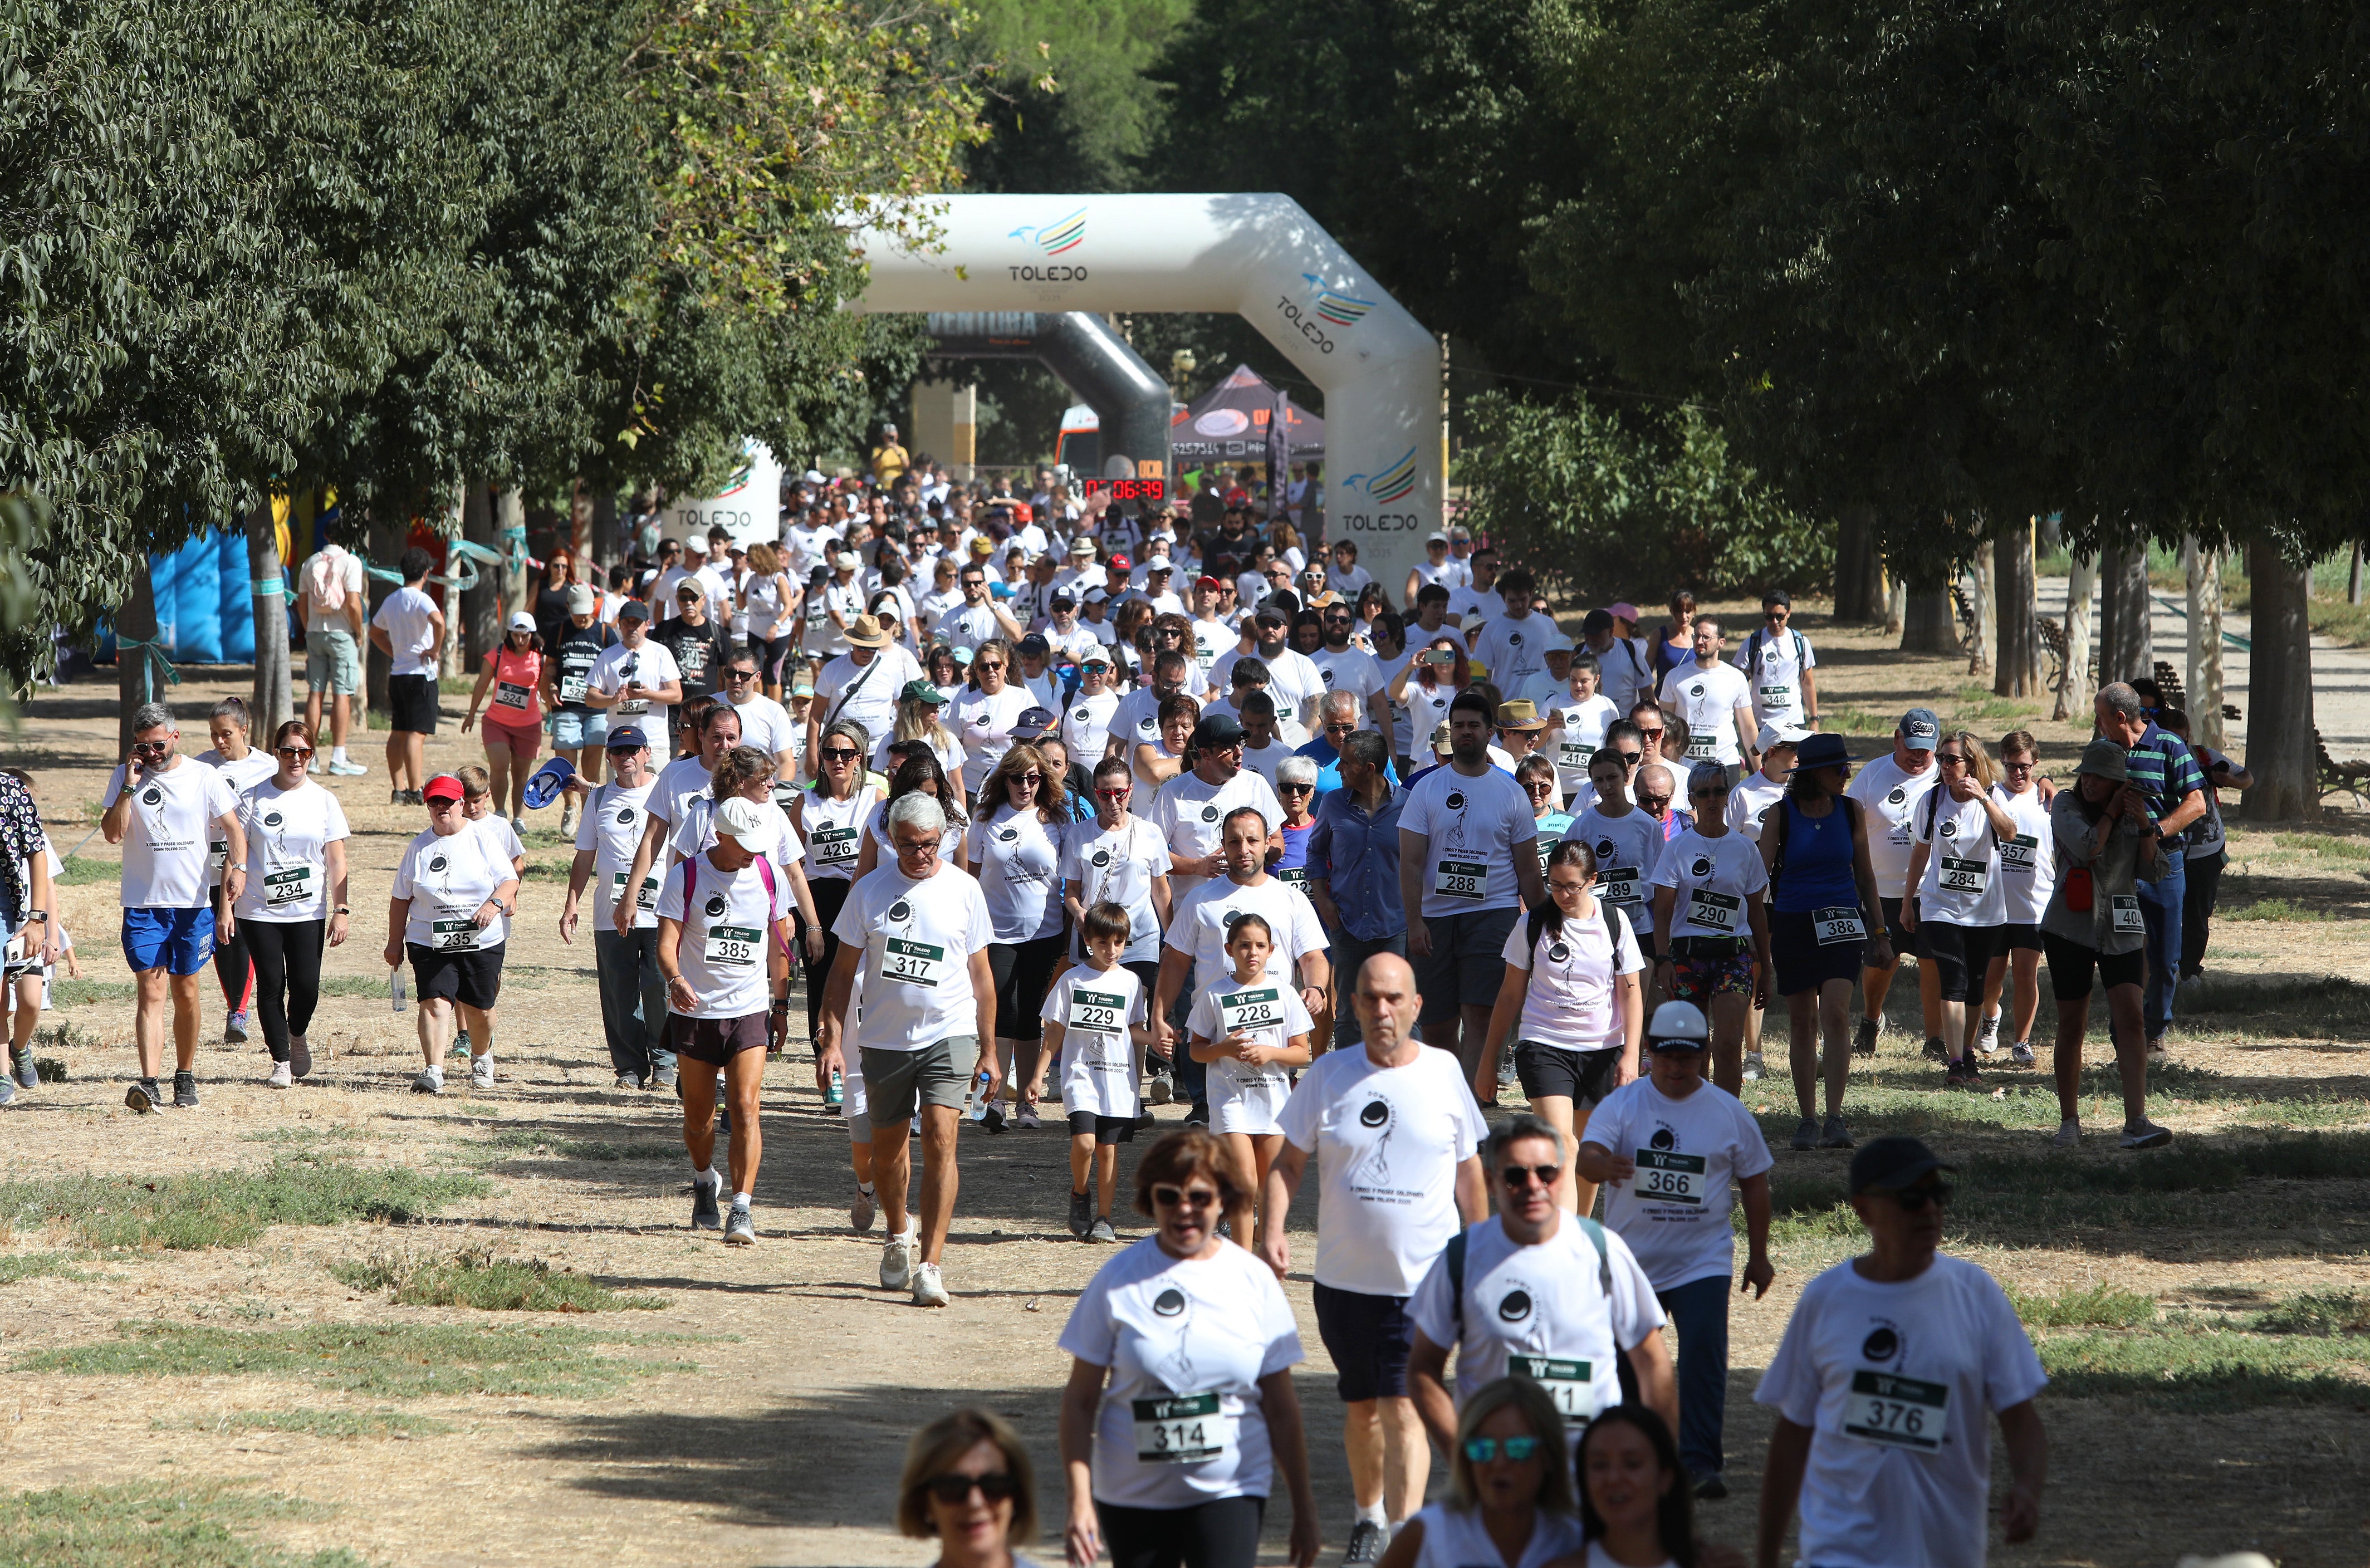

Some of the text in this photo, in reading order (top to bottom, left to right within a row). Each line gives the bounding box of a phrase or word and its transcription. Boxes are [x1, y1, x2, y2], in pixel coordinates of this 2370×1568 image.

[1008, 266, 1088, 281] TOLEDO
[1277, 295, 1334, 354] TOLEDO
[677, 509, 751, 526] TOLEDO
[1343, 514, 1418, 530] TOLEDO
[503, 692, 521, 704] 524
[569, 688, 588, 698] 525
[1767, 695, 1785, 704] 348
[622, 701, 640, 711] 387
[1689, 746, 1710, 756] 414
[1566, 753, 1587, 765] 415
[823, 841, 851, 857] 426
[2001, 845, 2028, 860] 357
[1446, 876, 1476, 891] 288
[1948, 871, 1976, 886] 284
[275, 881, 303, 899] 234
[709, 890, 725, 899] DOWN
[894, 895, 911, 903] DOWN
[1696, 905, 1727, 923] 290
[1827, 920, 1855, 935] 388
[443, 932, 471, 947] 235
[718, 941, 750, 958] 385
[895, 957, 931, 977] 317
[1081, 1007, 1114, 1025] 229
[1236, 1004, 1271, 1023] 228
[1648, 1172, 1690, 1194] 366
[1867, 1400, 1924, 1434] 376
[1154, 1423, 1205, 1449] 314
